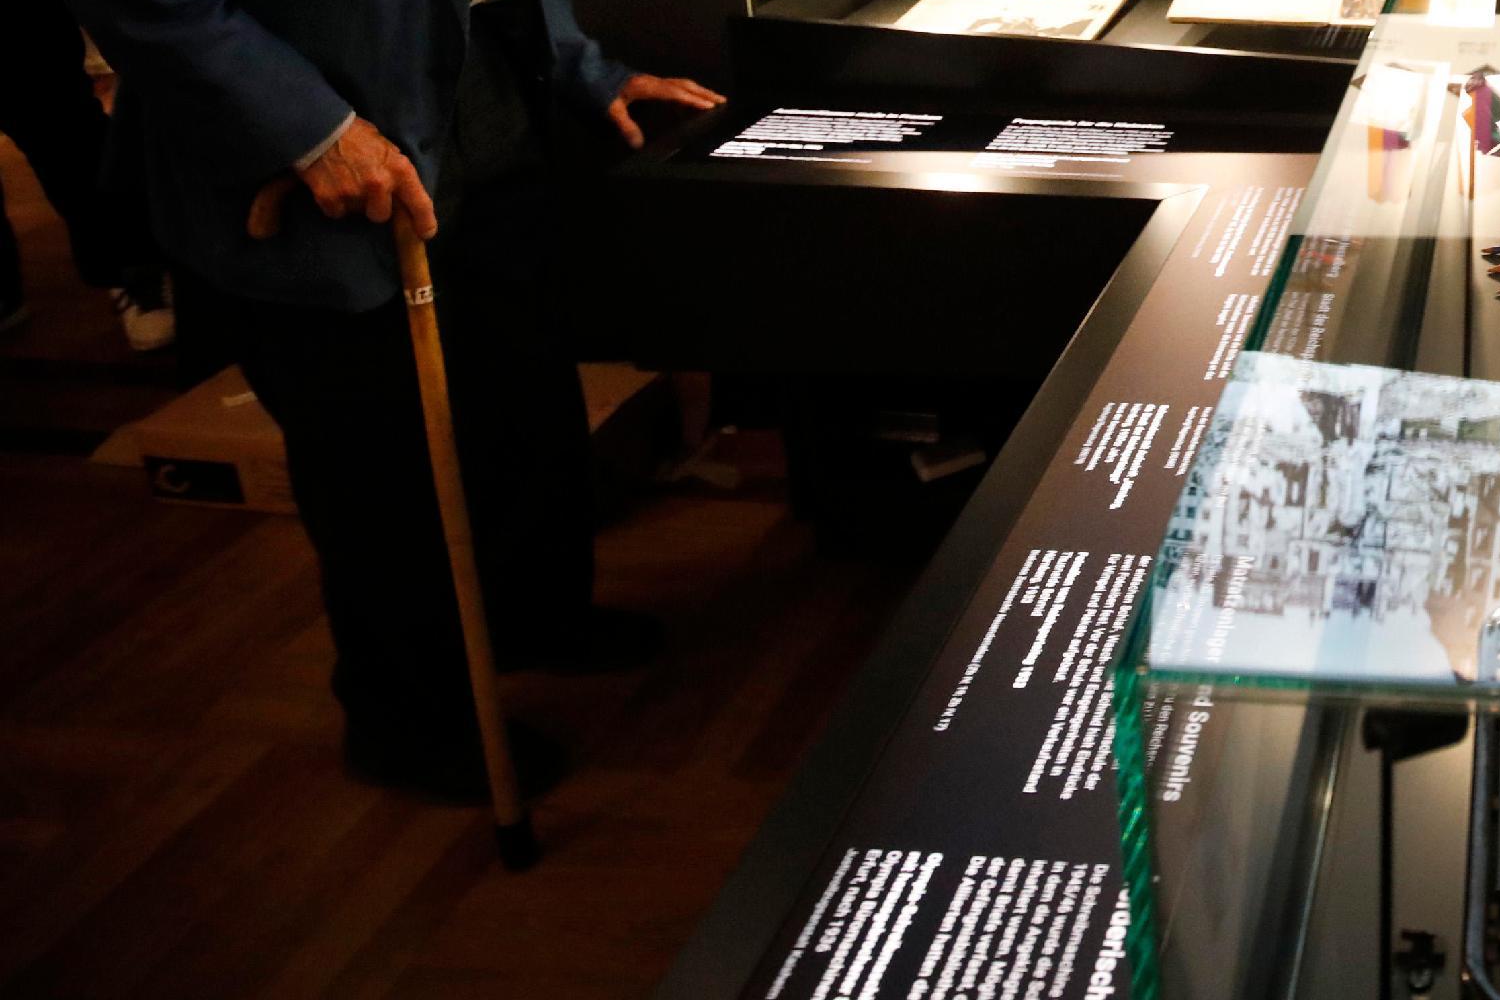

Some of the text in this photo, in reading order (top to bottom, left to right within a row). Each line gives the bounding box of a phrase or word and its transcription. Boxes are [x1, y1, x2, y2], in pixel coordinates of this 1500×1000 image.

[1023, 722, 1065, 793] Verkaufsstand
[1050, 766, 1065, 776] in
[1163, 711, 1209, 801] Souvenirs
[1060, 750, 1091, 799] Eindrücke
[866, 851, 903, 899] Olympia
[965, 856, 986, 876] Die
[987, 857, 1005, 877] der
[1000, 858, 1026, 892] damit
[1051, 861, 1067, 872] in
[834, 887, 860, 917] nach
[1040, 874, 1062, 902] dem
[984, 895, 1012, 932] Briefe
[1031, 904, 1050, 924] die
[815, 921, 844, 952] 1936
[1042, 915, 1066, 955] wurde
[1049, 864, 1109, 997] Die Schreibmaschine
[919, 934, 952, 977] hatten
[1033, 957, 1052, 978] die
